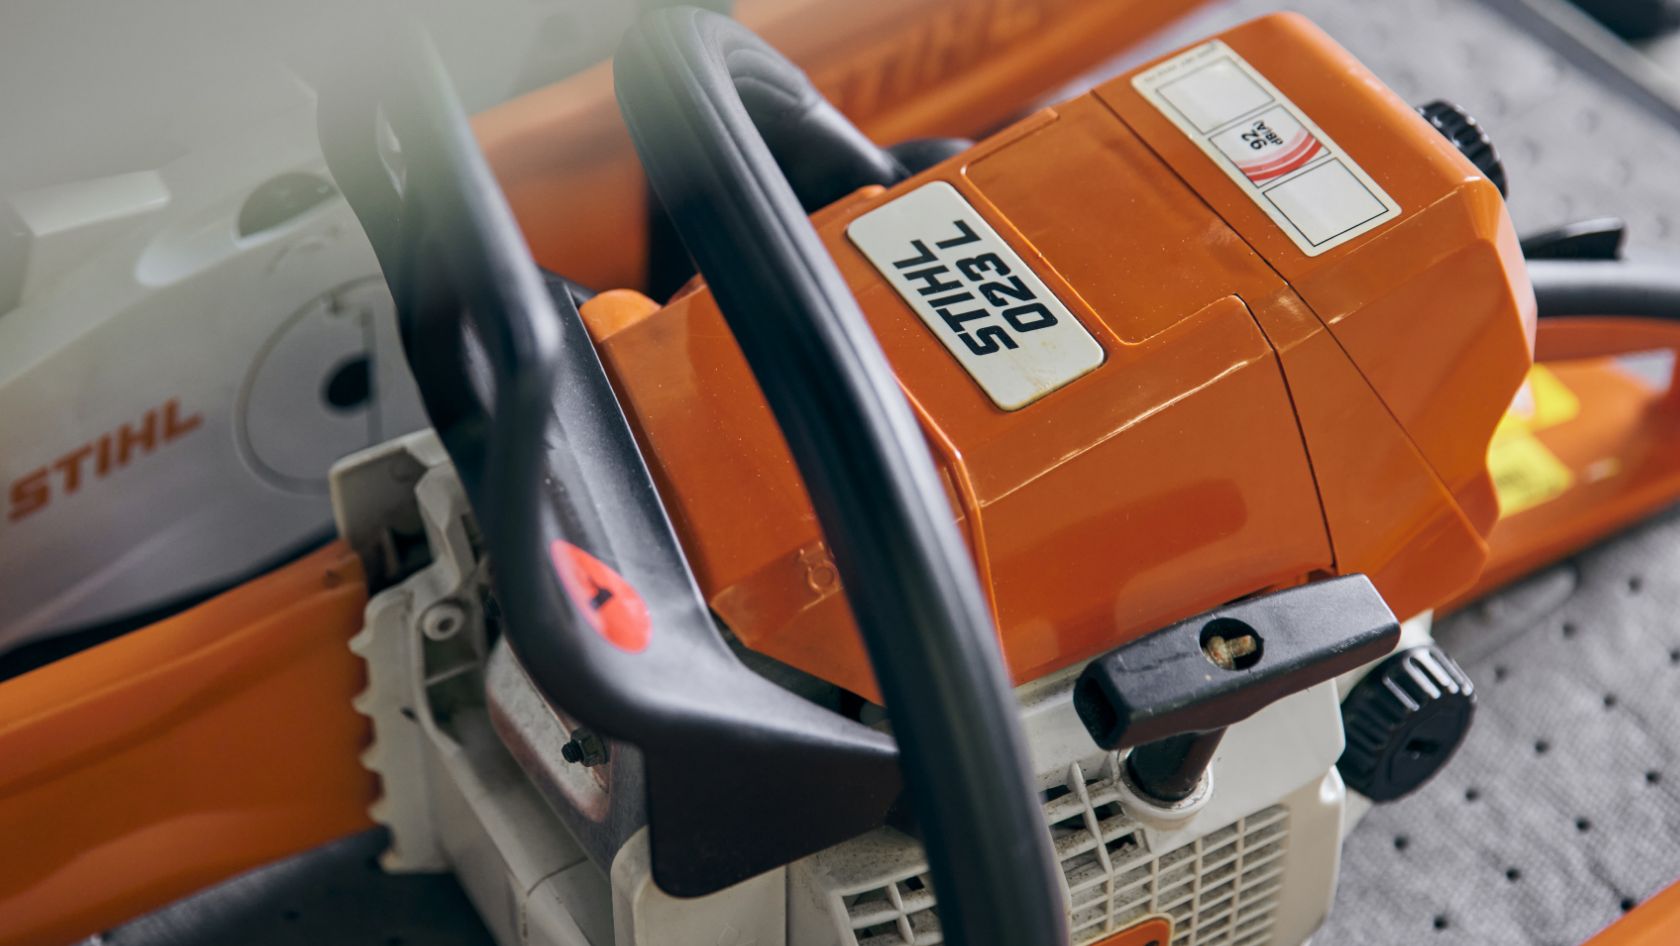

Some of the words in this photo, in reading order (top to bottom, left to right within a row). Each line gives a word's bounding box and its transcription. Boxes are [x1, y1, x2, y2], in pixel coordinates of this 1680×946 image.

[1241, 129, 1267, 150] 92
[1252, 120, 1284, 145] dB(A)
[935, 219, 982, 250] L
[892, 239, 1019, 356] STIHL
[955, 252, 1059, 333] 023
[7, 396, 204, 523] STIHL
